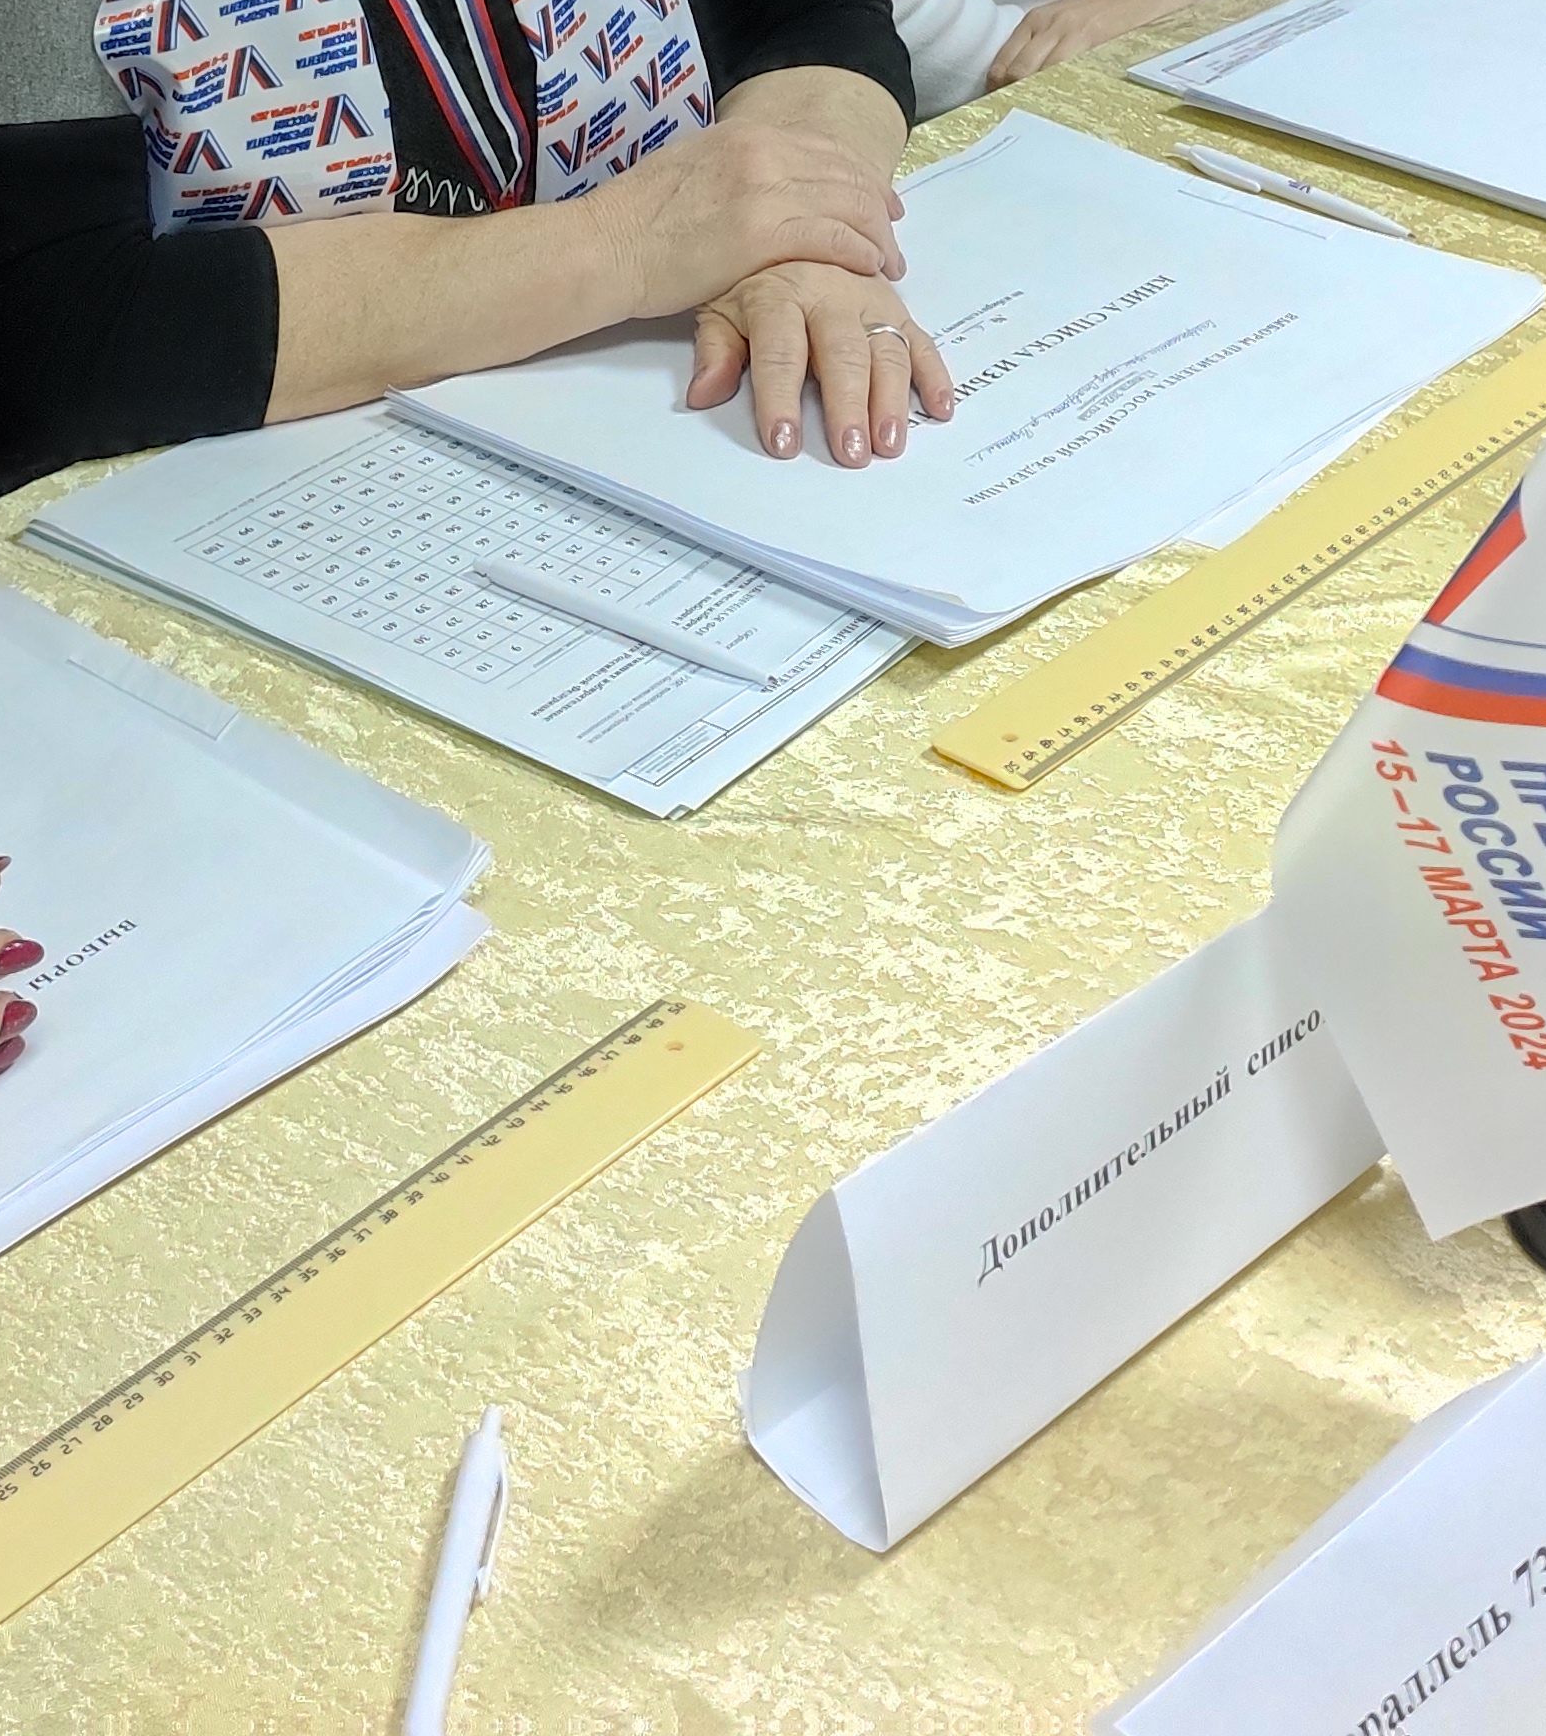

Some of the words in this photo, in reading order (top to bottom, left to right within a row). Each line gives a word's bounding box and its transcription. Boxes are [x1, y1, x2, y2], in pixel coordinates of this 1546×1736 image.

[1102, 274, 1177, 316] КНИГА
[1012, 310, 1112, 361] СПИСКА
[1055, 387, 1157, 459] РОССИЙСКОЙ
[961, 453, 1057, 507] ФЕДЕРАЦИИ
[26, 917, 140, 994] ВЫБОРЫ
[1419, 866, 1520, 983] МАРТА
[977, 1065, 1232, 1288] Дополнительный
[1246, 1009, 1325, 1077] списо
[29, 1459, 51, 1478] 26
[60, 1437, 83, 1456] 27
[91, 1414, 114, 1433] 28
[122, 1391, 145, 1410] 29
[154, 1371, 175, 1387] 30
[183, 1351, 202, 1366] 31
[213, 1328, 234, 1345] 32
[242, 1307, 263, 1324] 33
[270, 1286, 292, 1303] 34
[298, 1266, 319, 1283] 35
[326, 1247, 346, 1263] 36
[353, 1228, 372, 1243] 37
[379, 1209, 398, 1225] 38
[404, 1190, 424, 1206] 39
[430, 1171, 450, 1185] 40
[456, 1155, 473, 1167] 41
[481, 1135, 501, 1148] 42
[506, 1118, 526, 1130] 43
[530, 1100, 550, 1113] 44
[554, 1083, 574, 1096] 45
[578, 1066, 597, 1079] 46
[601, 1050, 619, 1063] 47
[623, 1033, 642, 1047] 48
[646, 1018, 663, 1031] 49
[667, 1002, 686, 1015] 50
[1346, 1602, 1513, 1736] раллель
